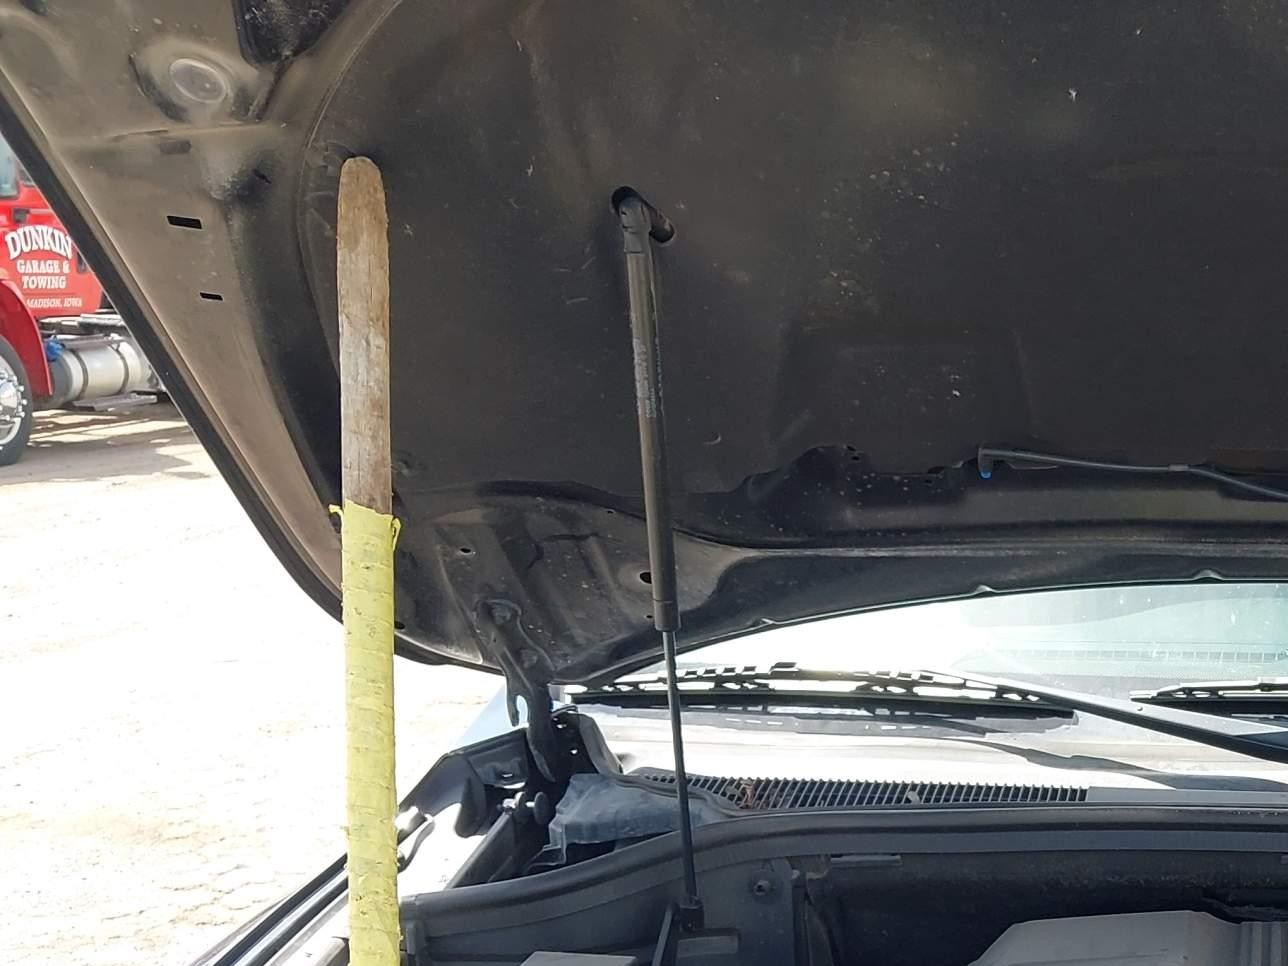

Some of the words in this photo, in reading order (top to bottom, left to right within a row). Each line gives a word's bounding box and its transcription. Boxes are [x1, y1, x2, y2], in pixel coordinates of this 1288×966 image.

[5, 225, 72, 260] DUNKIN
[17, 259, 60, 273] GARAGE
[62, 260, 70, 274] &
[22, 275, 66, 289] TOWING
